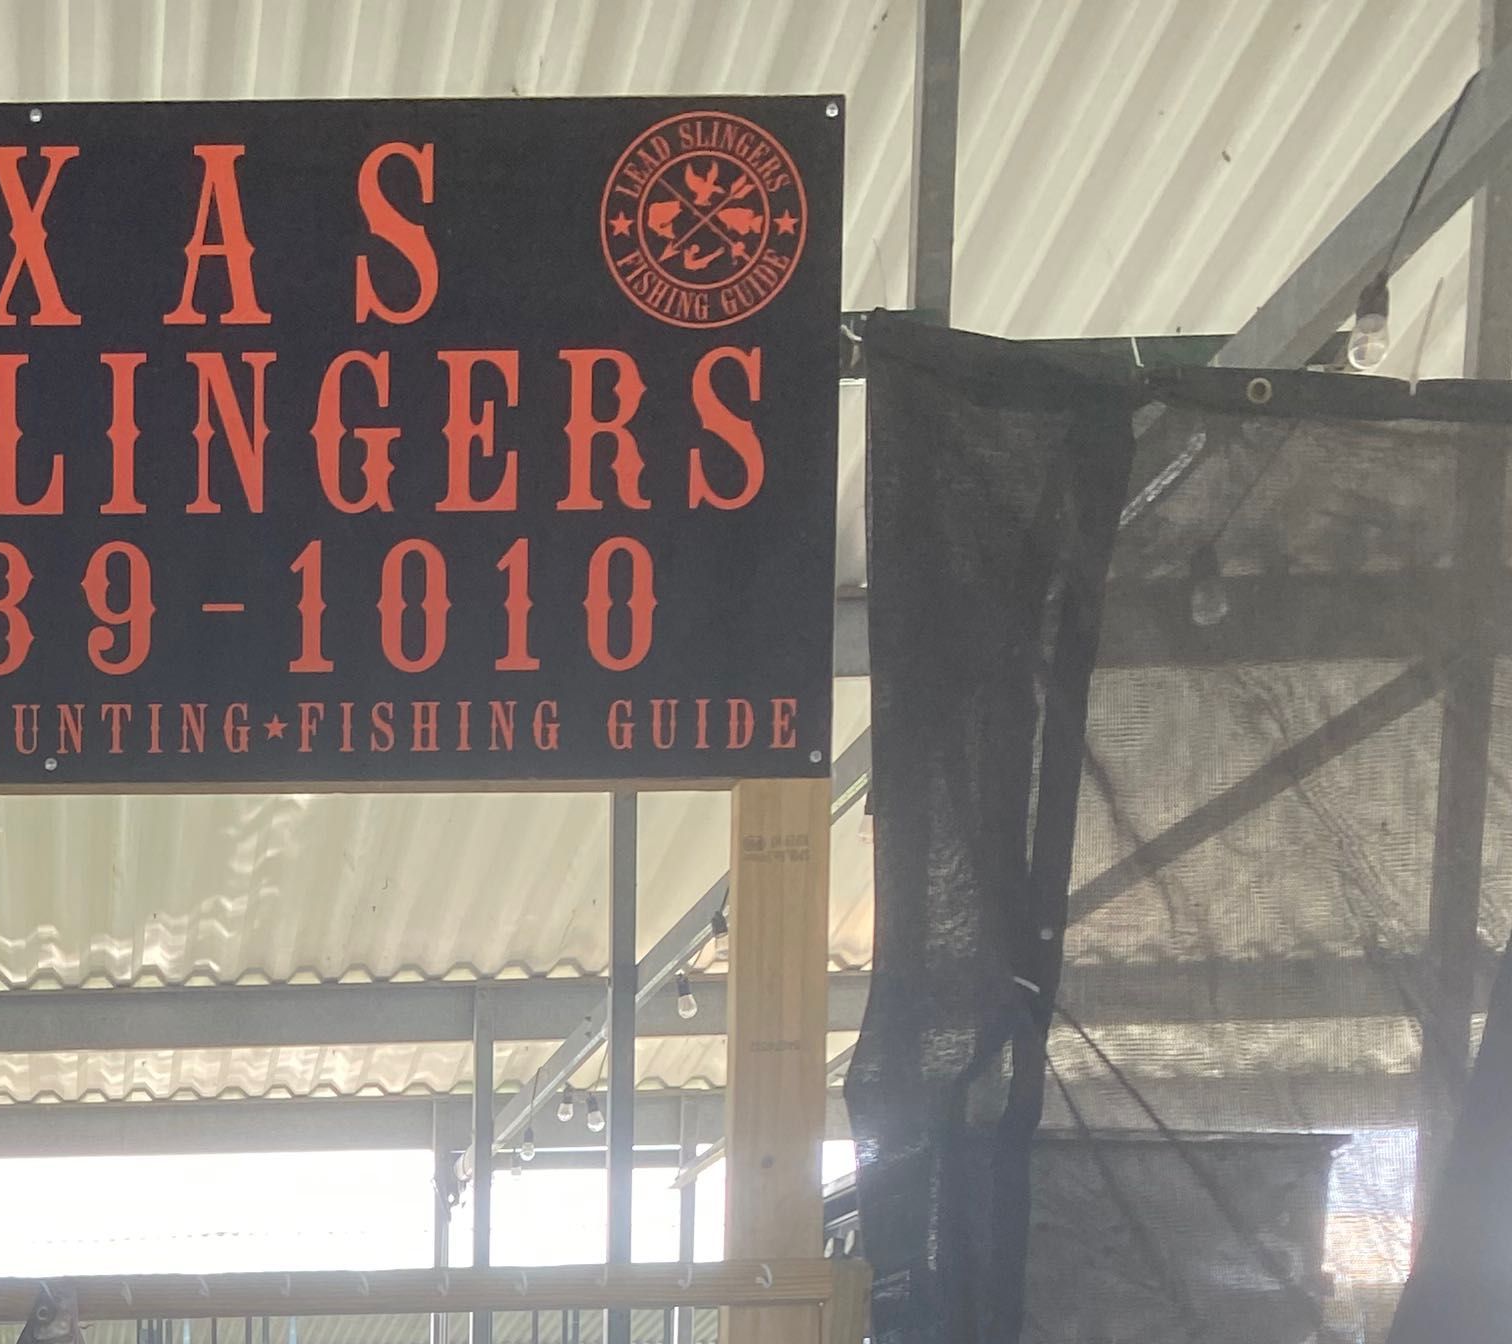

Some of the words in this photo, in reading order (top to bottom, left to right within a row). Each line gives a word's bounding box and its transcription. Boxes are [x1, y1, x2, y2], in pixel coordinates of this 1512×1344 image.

[615, 135, 671, 199] LEAD
[678, 120, 791, 193] SLINGERS
[616, 250, 709, 321] FISHING
[720, 247, 791, 317] GUIDE
[298, 700, 561, 753] FISHING
[607, 698, 797, 749] GUIDE
